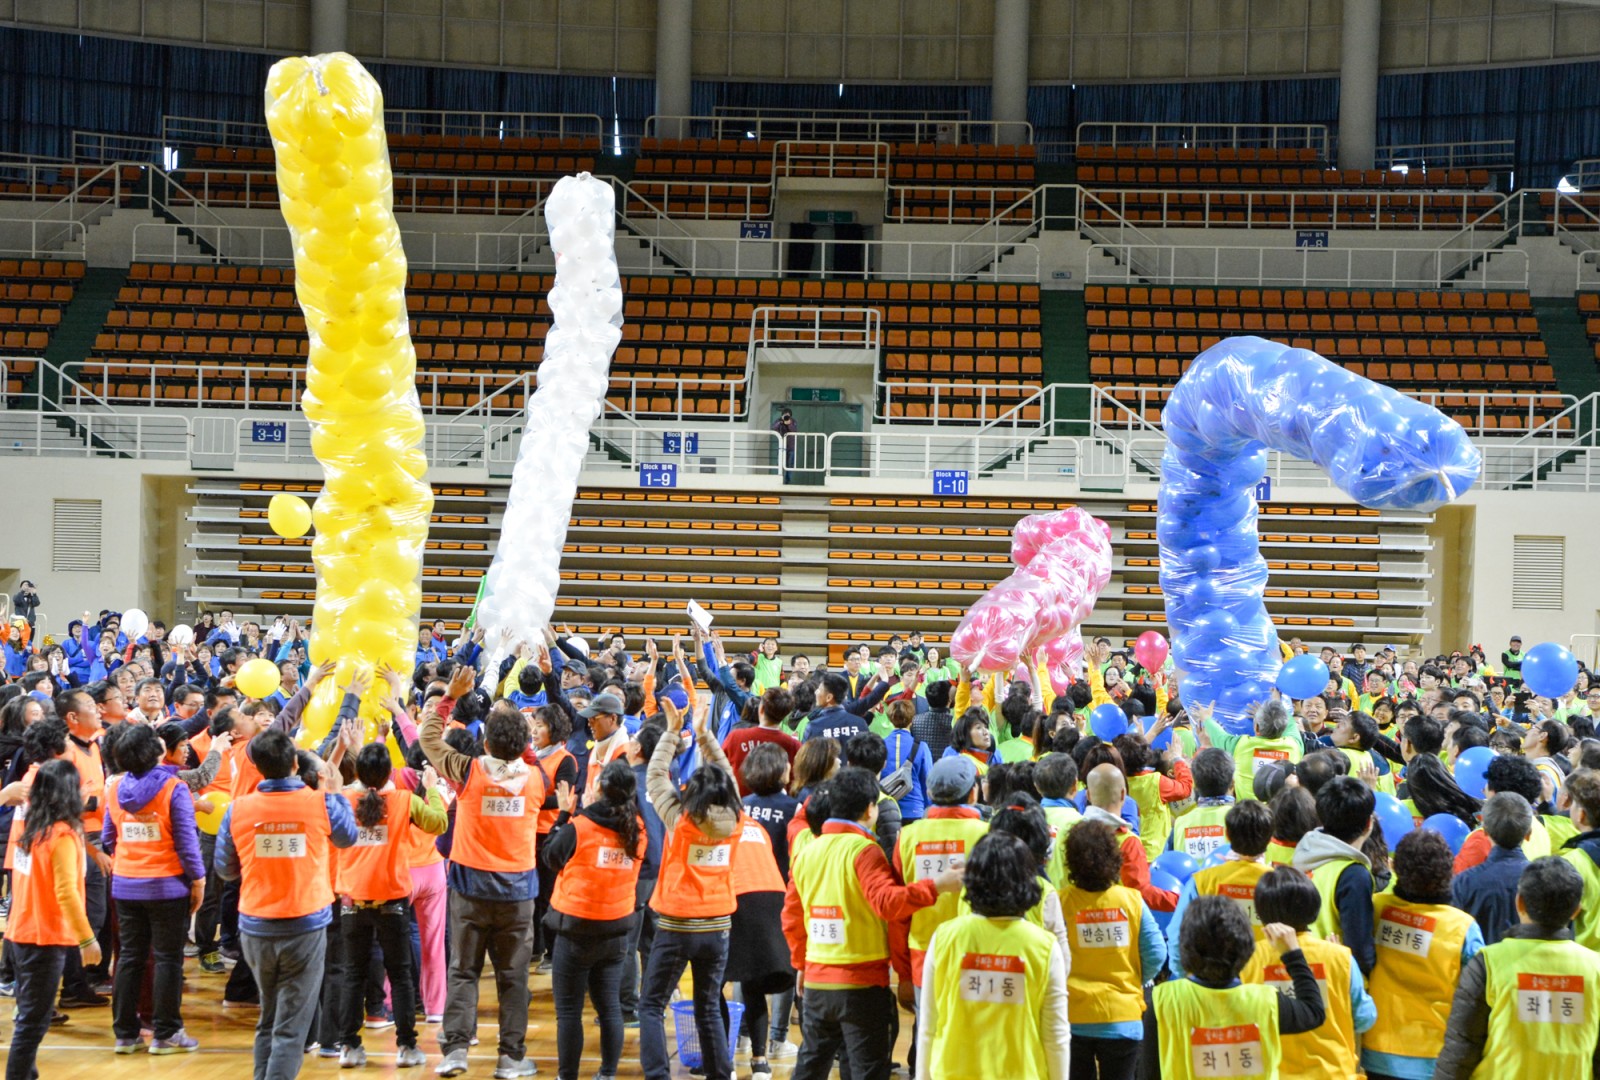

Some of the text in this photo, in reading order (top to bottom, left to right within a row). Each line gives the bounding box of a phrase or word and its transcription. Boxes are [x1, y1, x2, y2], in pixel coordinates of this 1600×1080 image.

[745, 230, 766, 239] 4-7
[1302, 239, 1323, 248] 4-8
[258, 428, 282, 442] 3-9
[668, 440, 692, 453] 3-0
[645, 472, 671, 486] 1-9
[937, 479, 965, 493] 1-10
[823, 726, 859, 738] 해운대구
[486, 799, 520, 813] 재송2동
[1082, 926, 1124, 944] 반송1동
[1381, 924, 1424, 951] 반송1동
